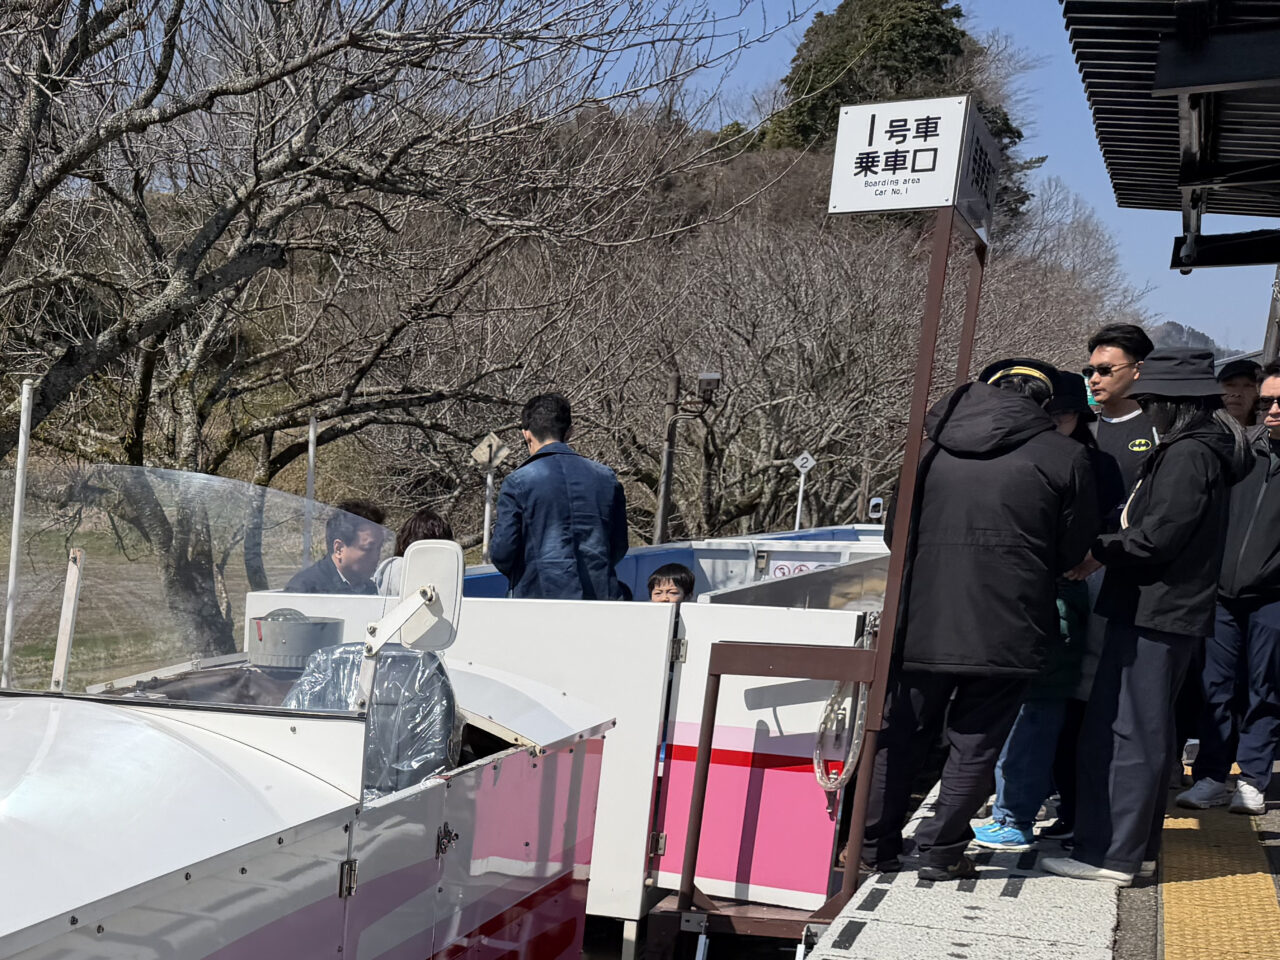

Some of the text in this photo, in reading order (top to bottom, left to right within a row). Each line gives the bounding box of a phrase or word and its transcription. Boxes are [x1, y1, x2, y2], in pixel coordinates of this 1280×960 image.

[853, 148, 938, 177] 乗車口
[864, 177, 921, 188] Boarding area
[874, 188, 888, 196] Car
[891, 187, 903, 196] No.
[487, 443, 493, 464] 1
[800, 456, 809, 469] 2
